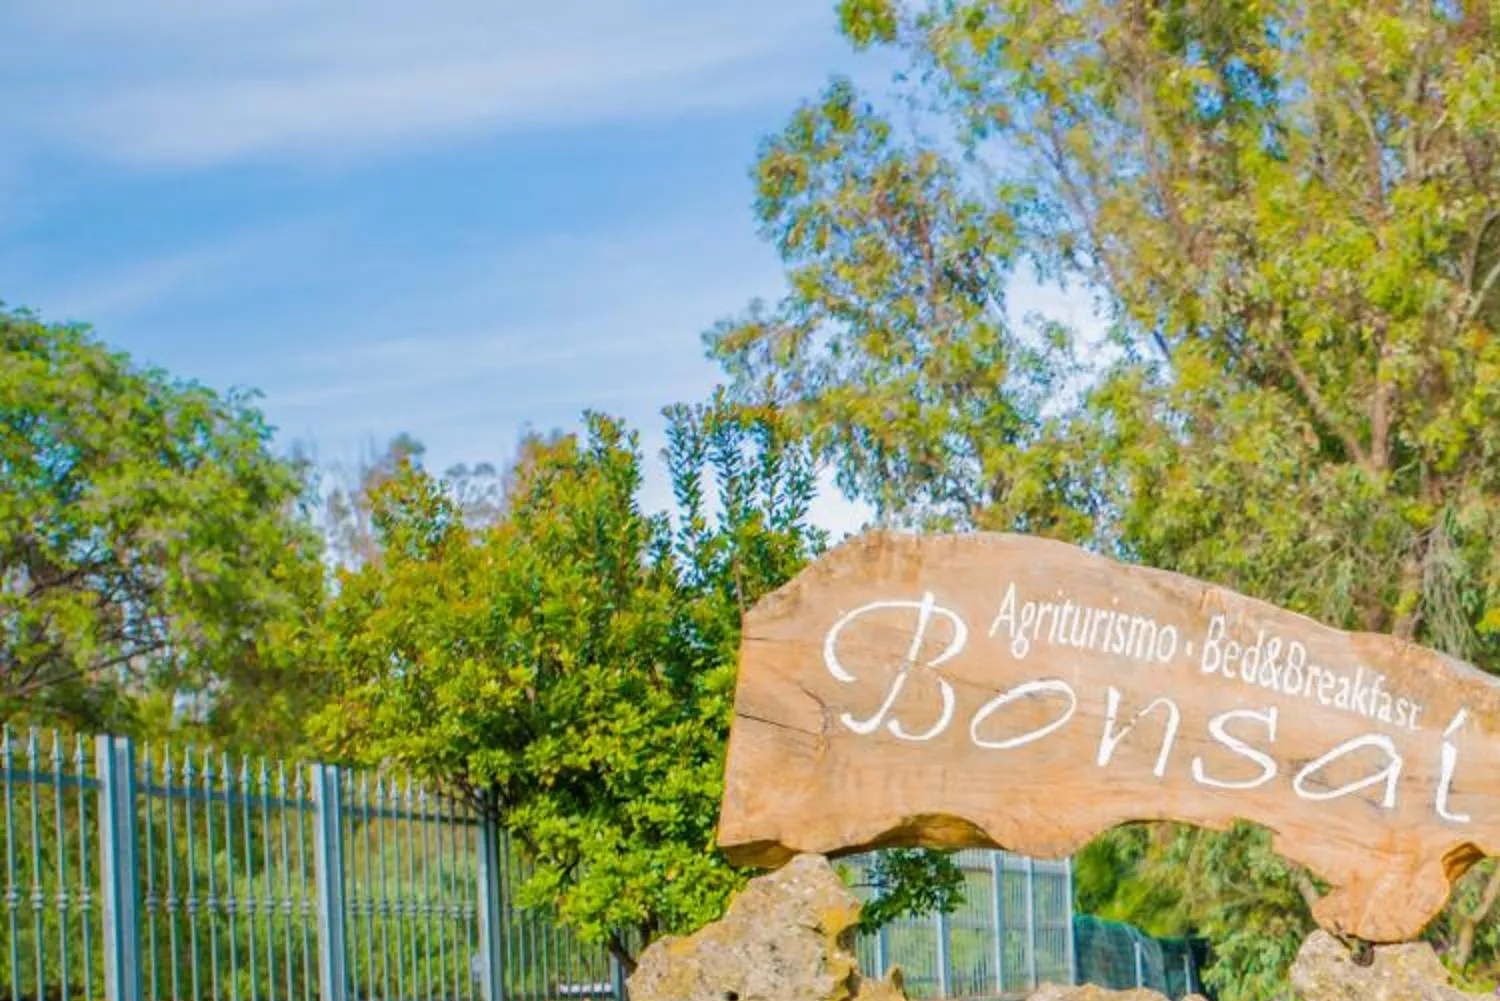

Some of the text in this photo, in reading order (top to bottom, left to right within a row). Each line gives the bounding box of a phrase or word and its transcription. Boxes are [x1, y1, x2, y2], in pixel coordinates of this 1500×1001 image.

[823, 591, 1472, 823] Bonsai
[988, 581, 1423, 731] Agriturismo Bed&Breakfast
